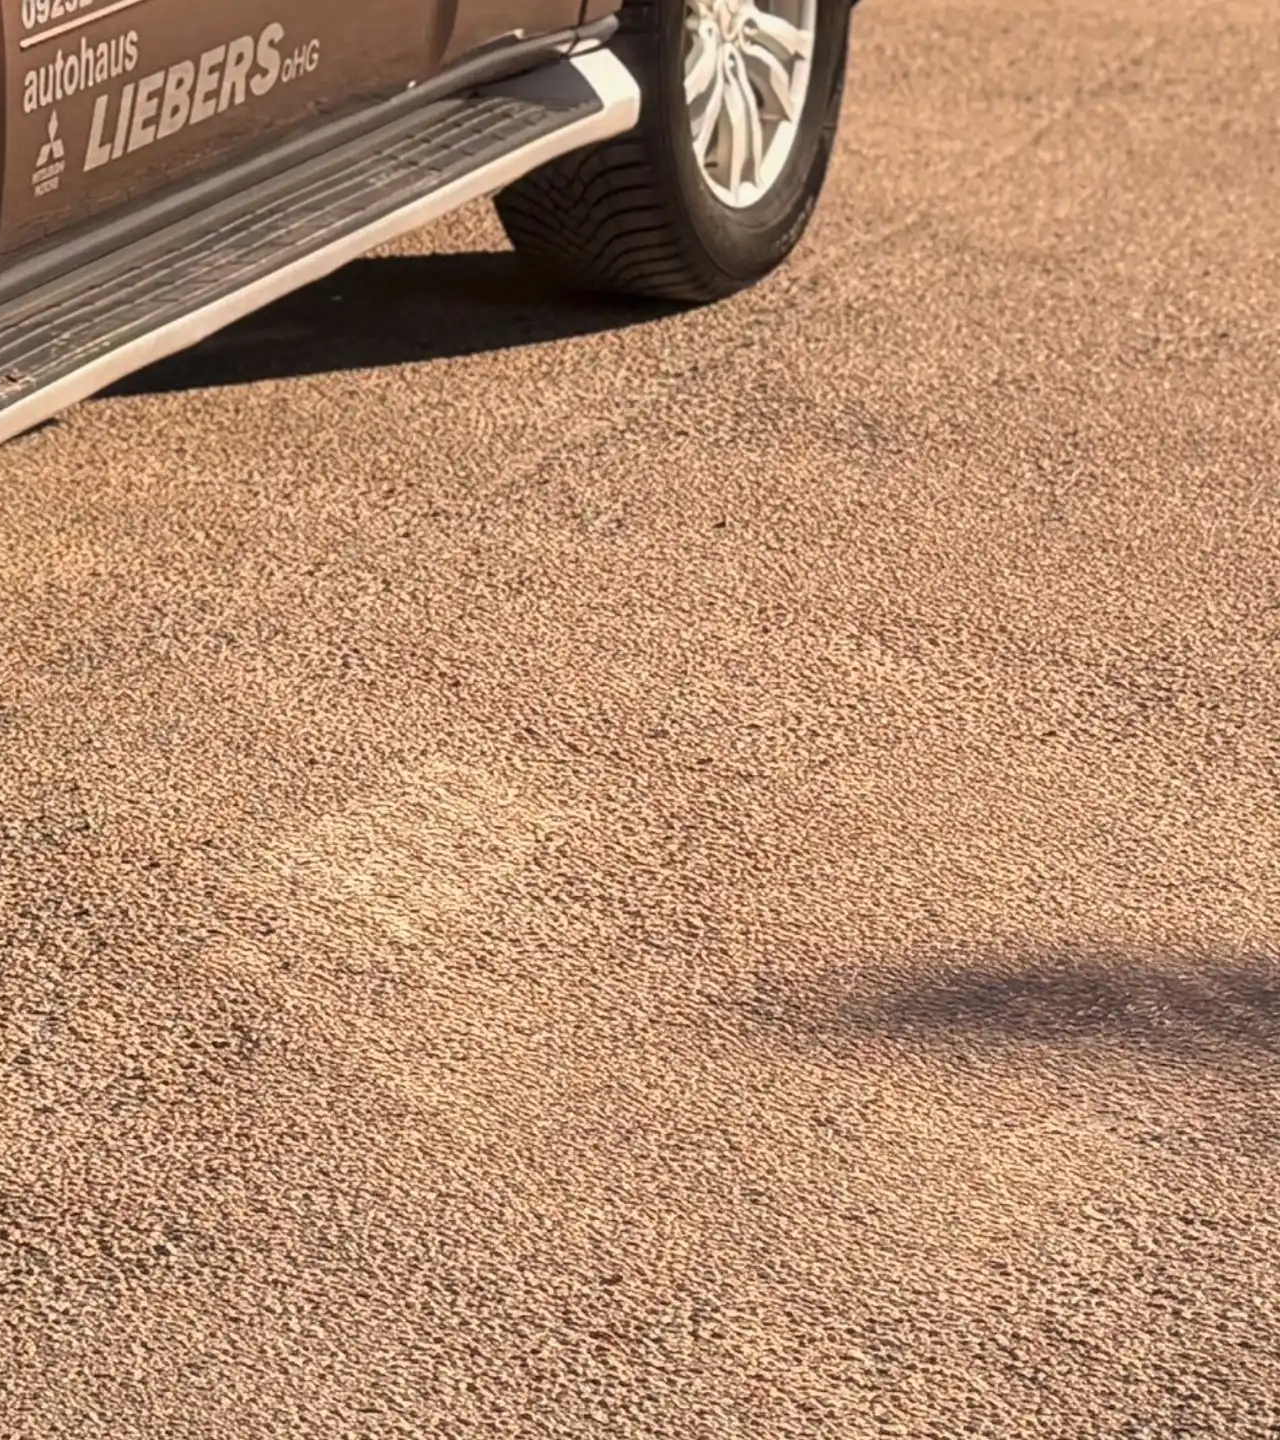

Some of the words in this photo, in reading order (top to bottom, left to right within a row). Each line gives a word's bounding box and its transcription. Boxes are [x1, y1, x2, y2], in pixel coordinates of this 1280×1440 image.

[23, 30, 139, 114] autohaus
[83, 22, 285, 172] LIEBERS
[281, 38, 320, 82] oHG
